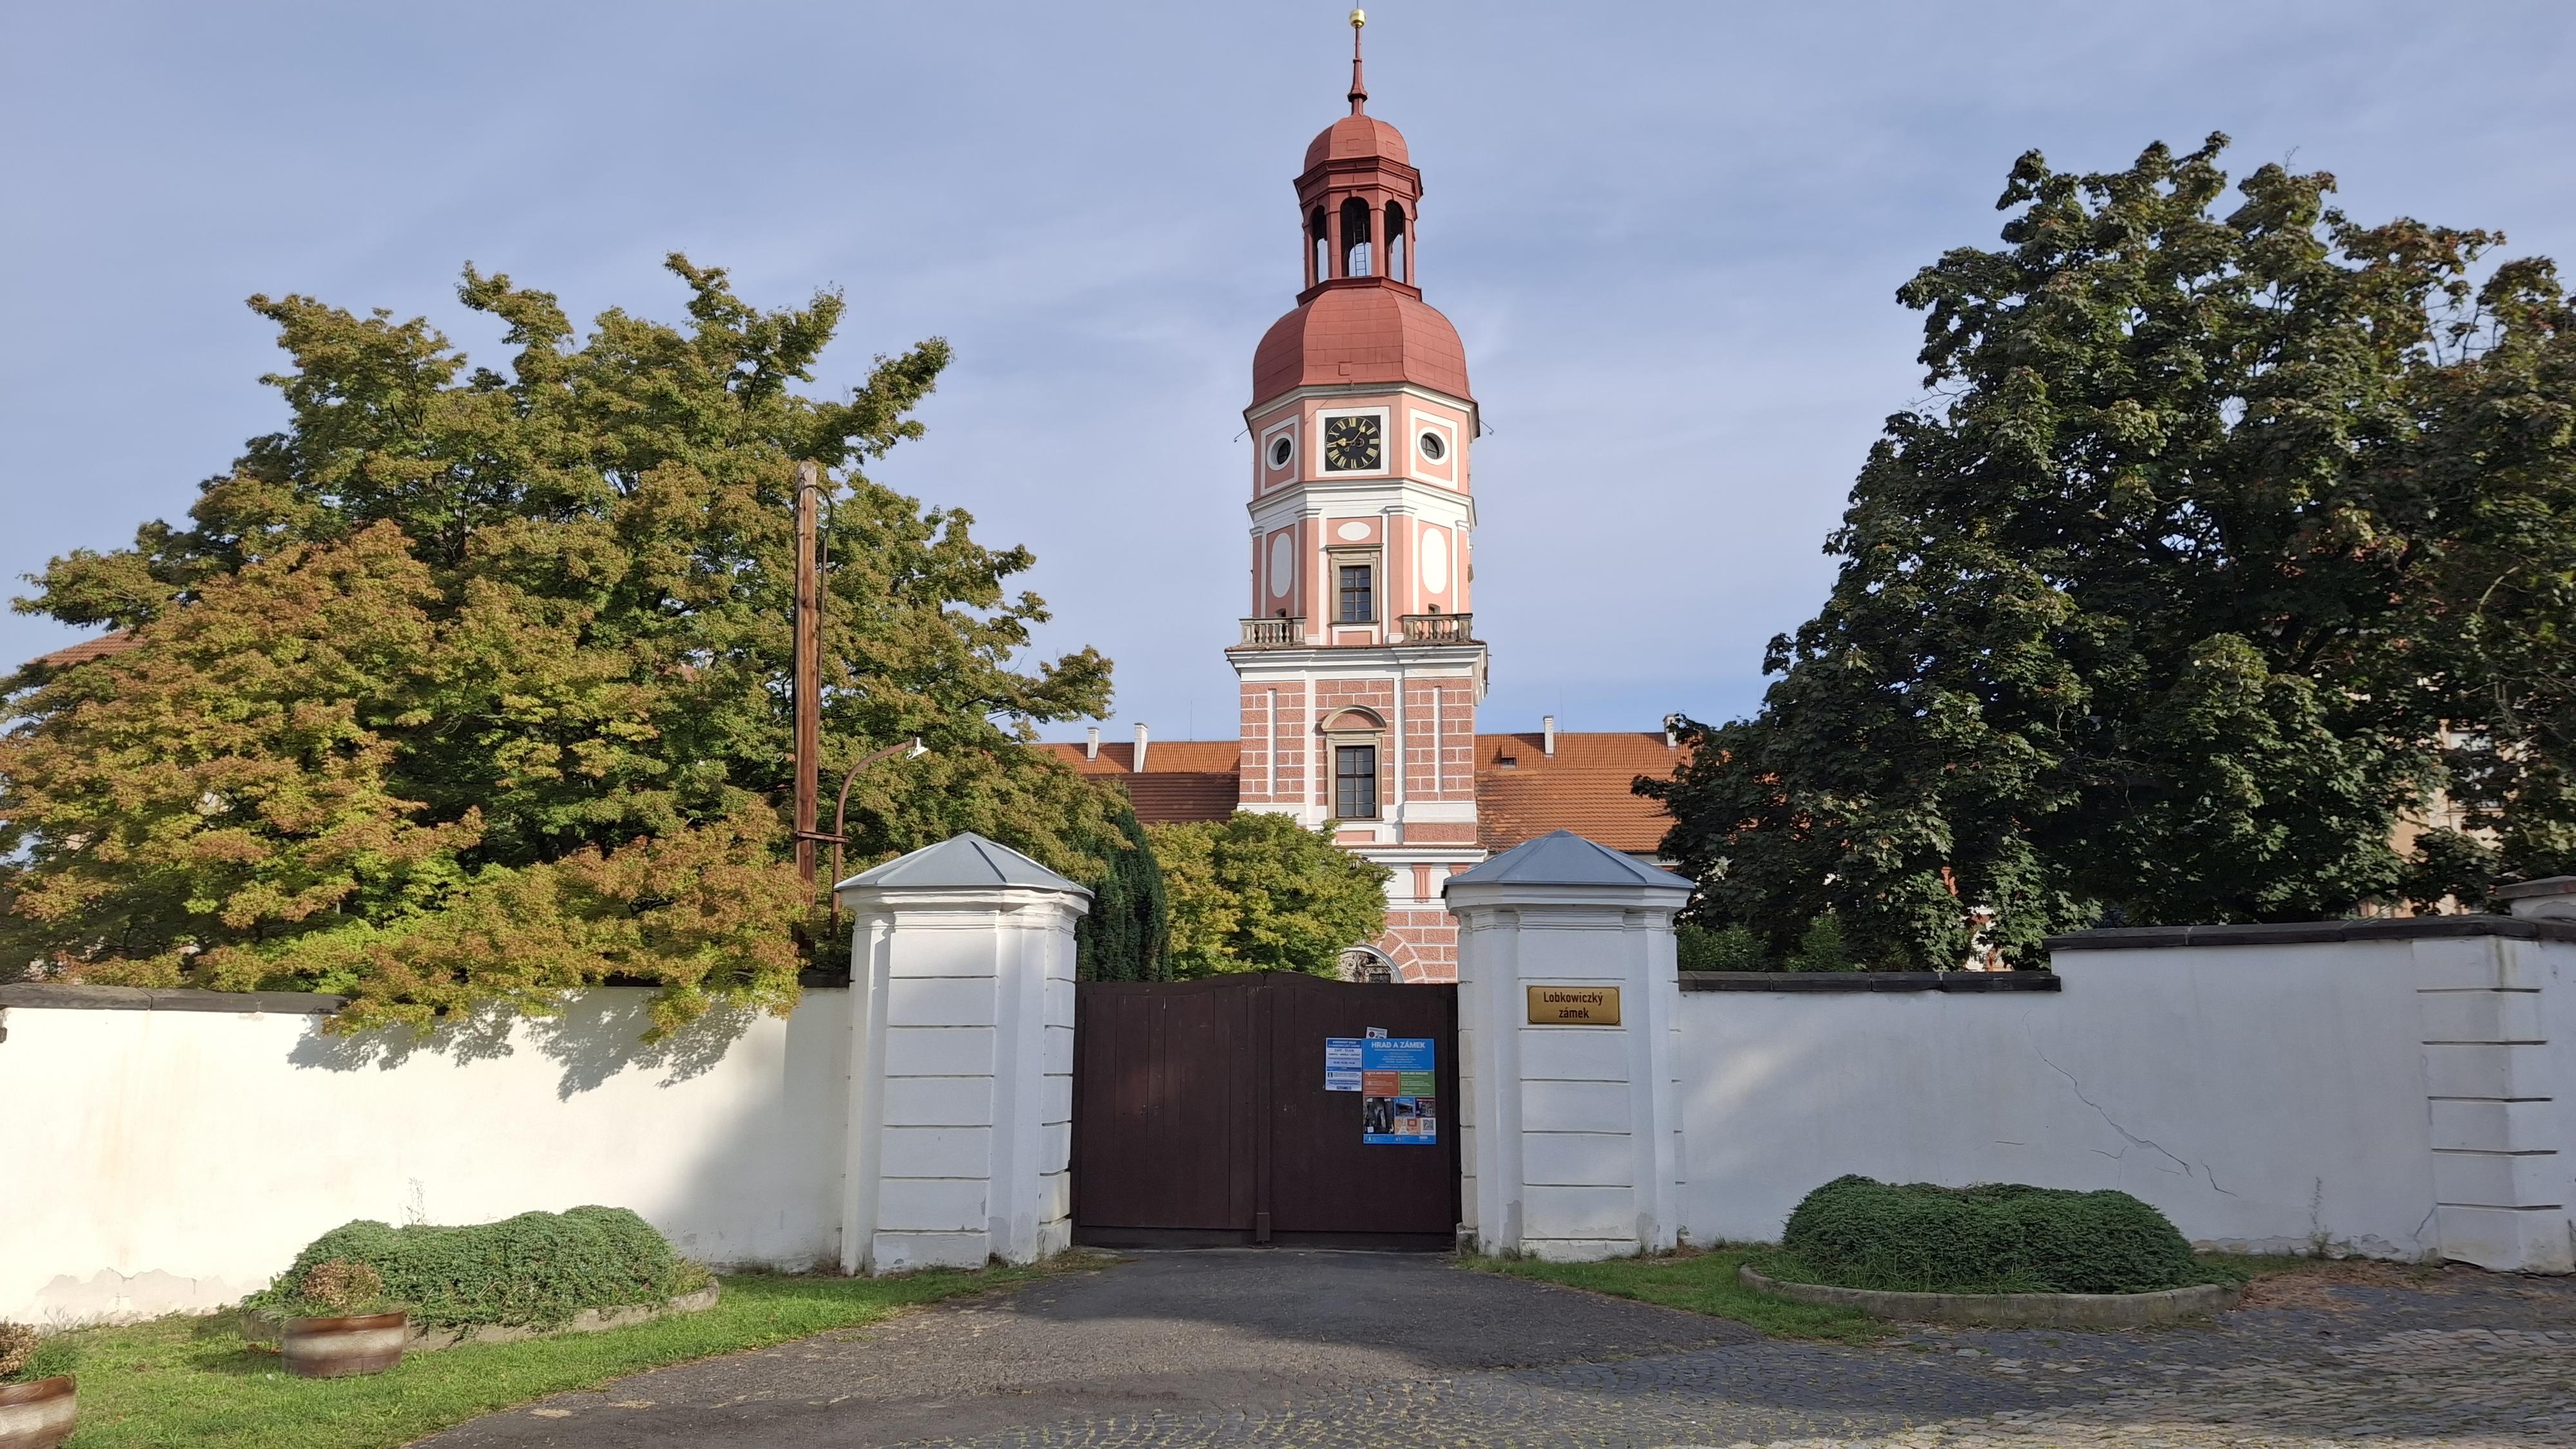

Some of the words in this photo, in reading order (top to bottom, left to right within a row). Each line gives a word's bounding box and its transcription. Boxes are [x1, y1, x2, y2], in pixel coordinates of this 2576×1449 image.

[1543, 991, 1603, 1006] Lobkowiczký
[1558, 1007, 1589, 1018] zámek
[1399, 1040, 1426, 1048] ZÁMEK
